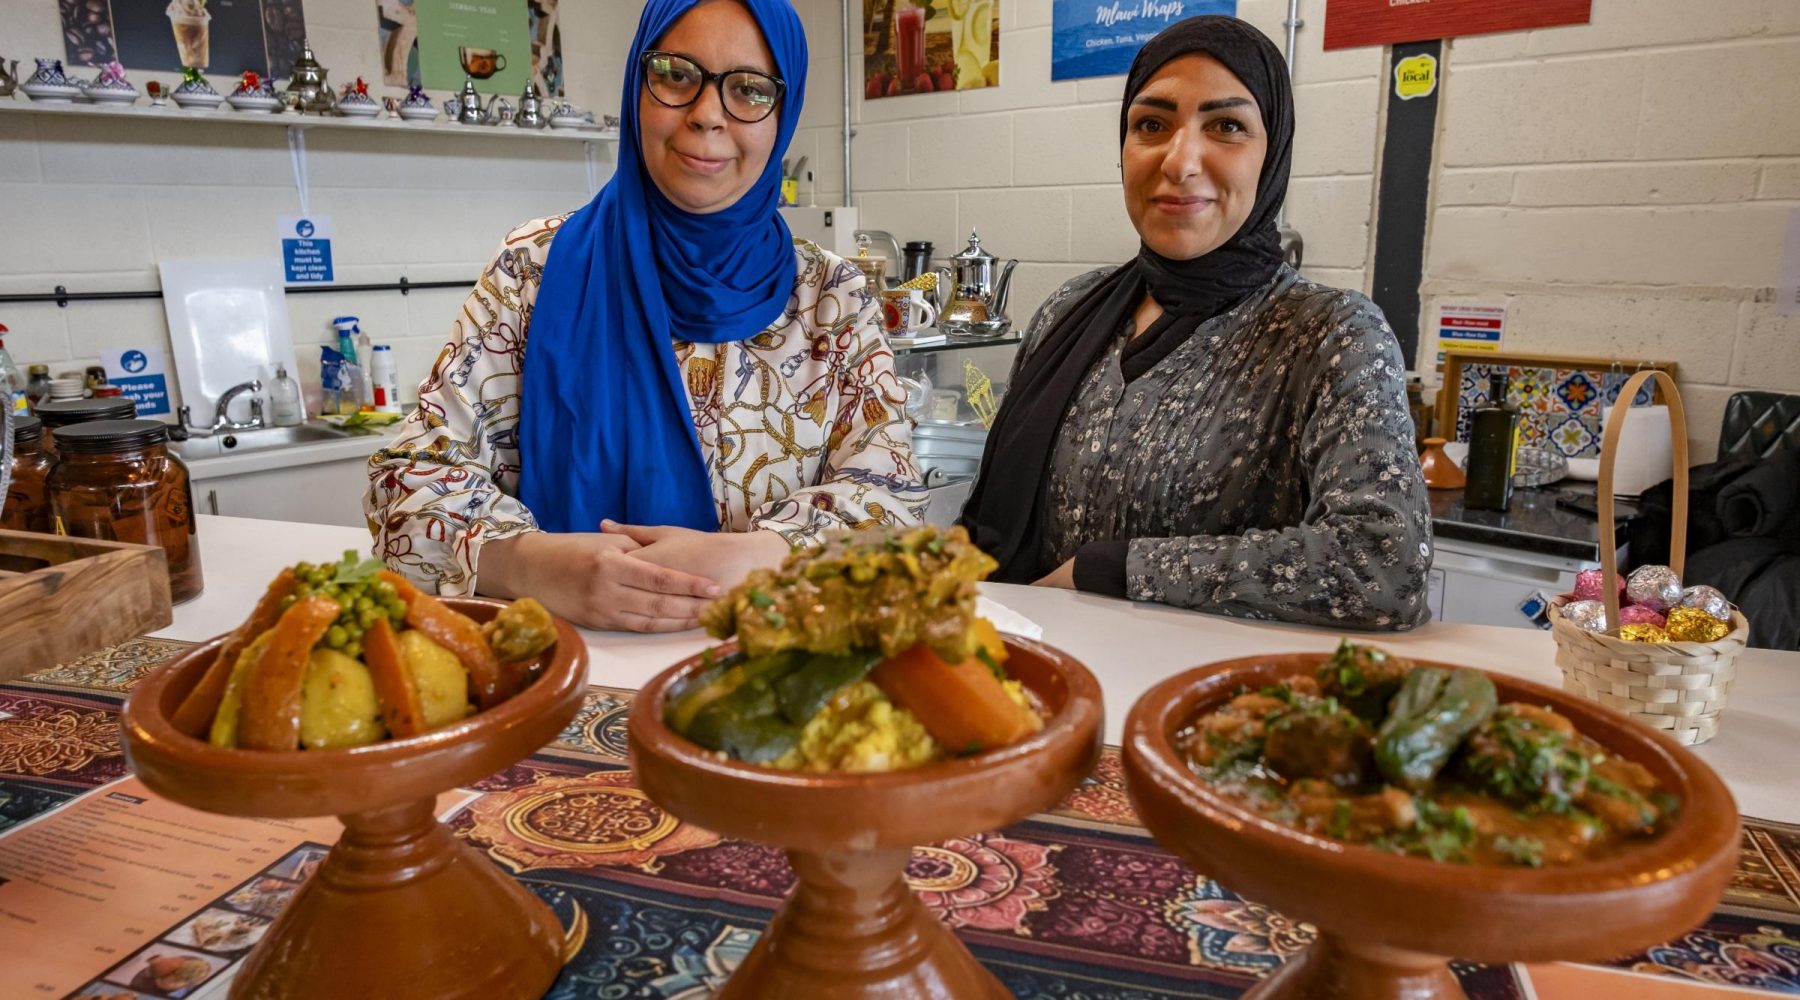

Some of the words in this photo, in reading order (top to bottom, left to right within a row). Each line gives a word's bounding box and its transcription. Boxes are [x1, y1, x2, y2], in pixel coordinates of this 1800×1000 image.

[1142, 0, 1185, 22] Wraps
[1403, 70, 1429, 82] local
[308, 264, 327, 272] clean
[296, 272, 309, 280] and
[121, 383, 154, 392] Please
[143, 391, 164, 401] your
